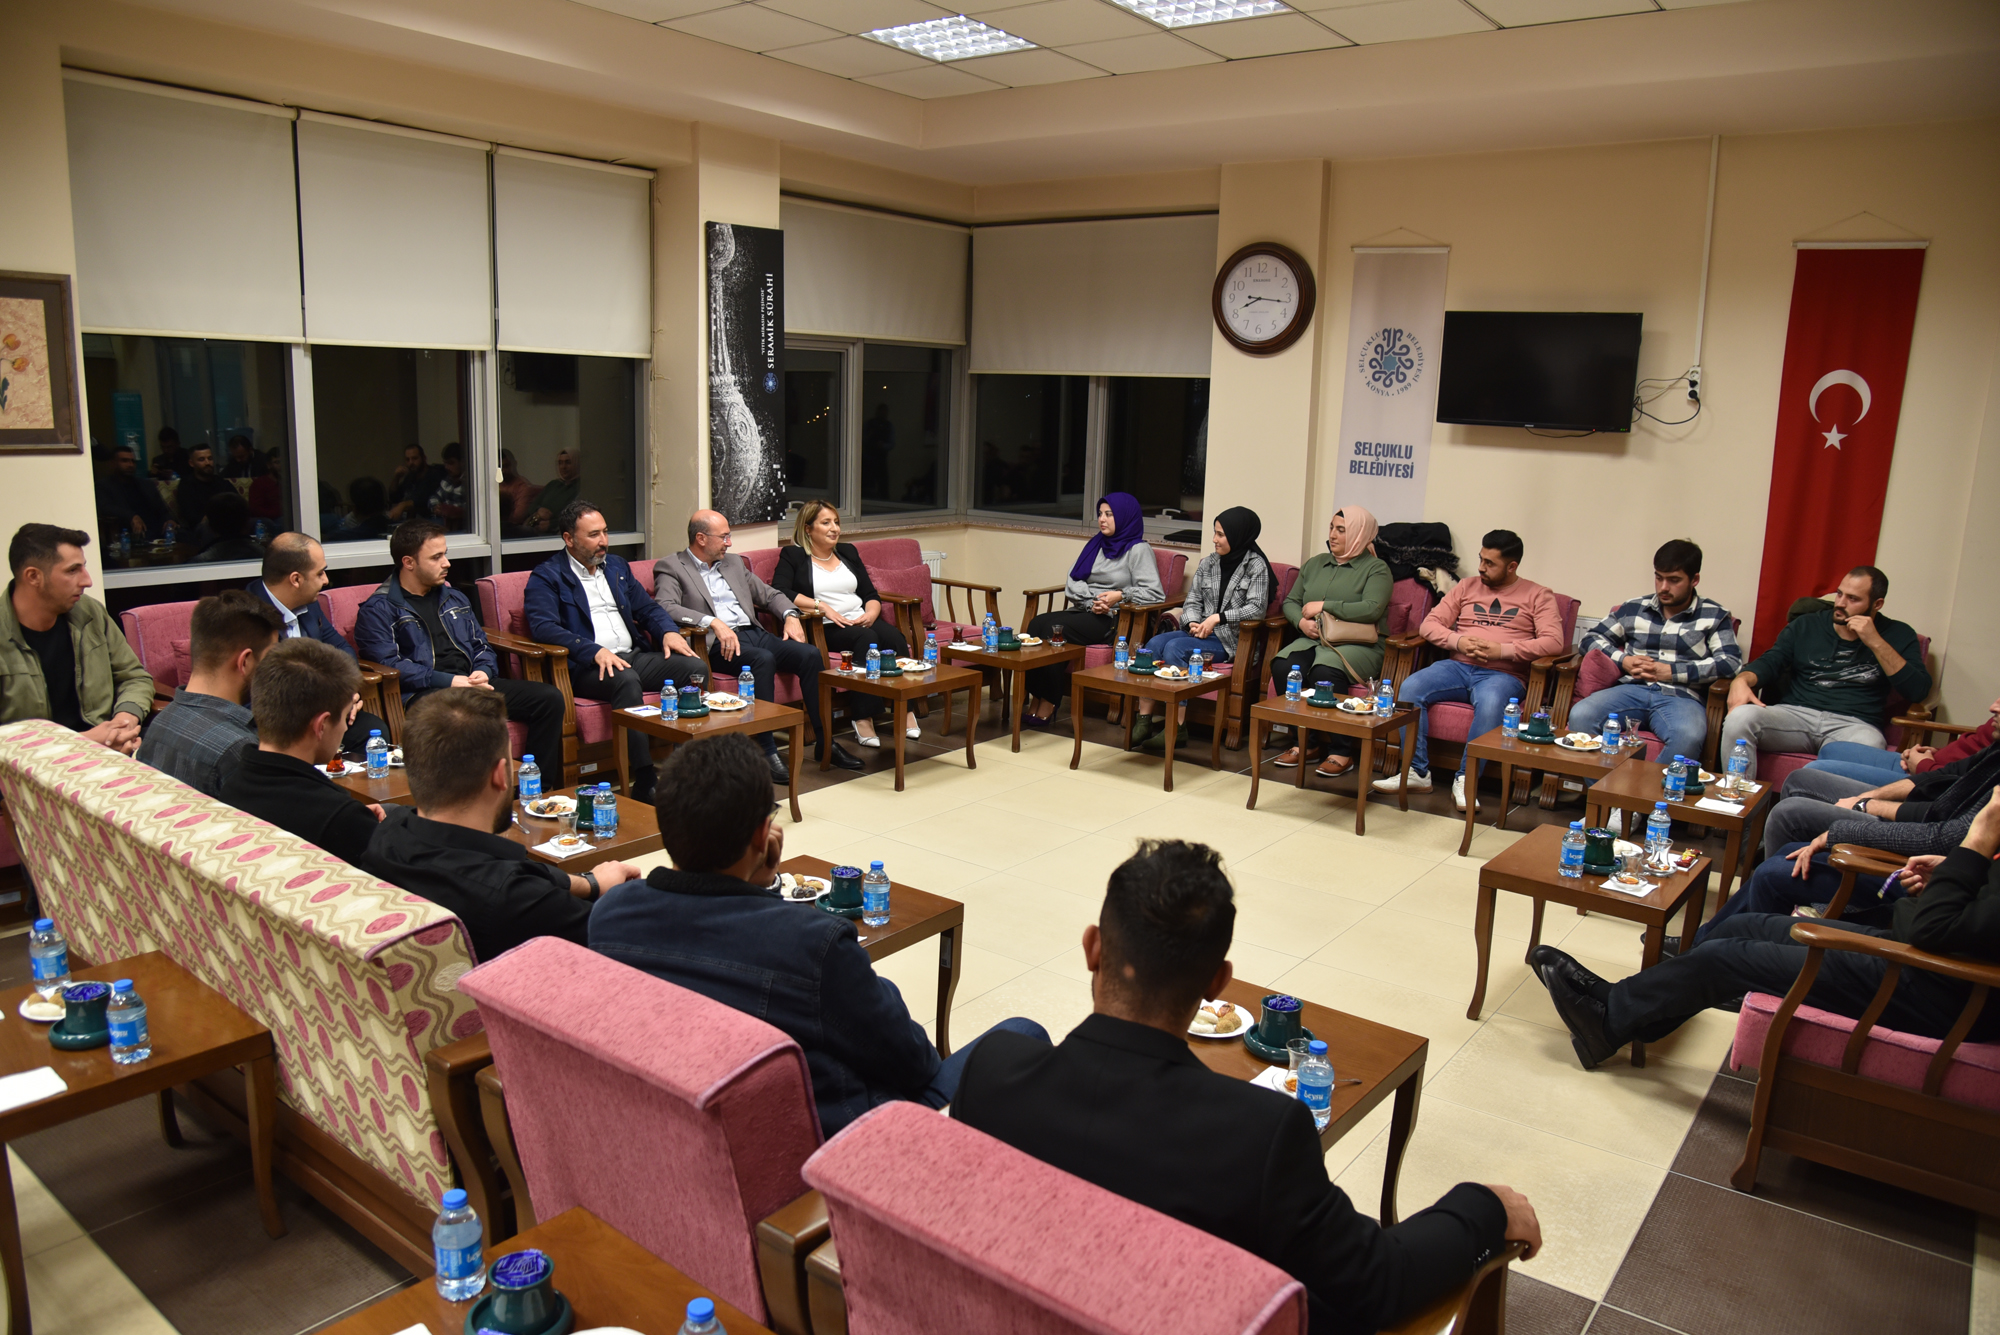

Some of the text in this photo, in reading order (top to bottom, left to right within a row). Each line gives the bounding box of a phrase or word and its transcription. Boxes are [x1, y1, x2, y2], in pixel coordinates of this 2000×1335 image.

[1244, 267, 1252, 278] 11
[1257, 262, 1268, 273] 12
[1274, 267, 1278, 278] 1
[1233, 280, 1245, 291] 10
[1281, 277, 1288, 288] 2
[1229, 293, 1236, 303] 9
[1286, 293, 1292, 303] 3
[1232, 308, 1239, 319] 8
[1280, 308, 1287, 318] 4
[1243, 319, 1250, 330] 7
[1255, 324, 1262, 334] 6
[1271, 320, 1277, 330] 5
[766, 319, 775, 369] SERAMİK
[1358, 331, 1425, 383] SELÇUKLU BELEDİYESİ
[1365, 380, 1412, 397] KONYA 1989
[1354, 441, 1413, 461] SELÇUKLU
[1349, 460, 1414, 479] BELEDİYESİ
